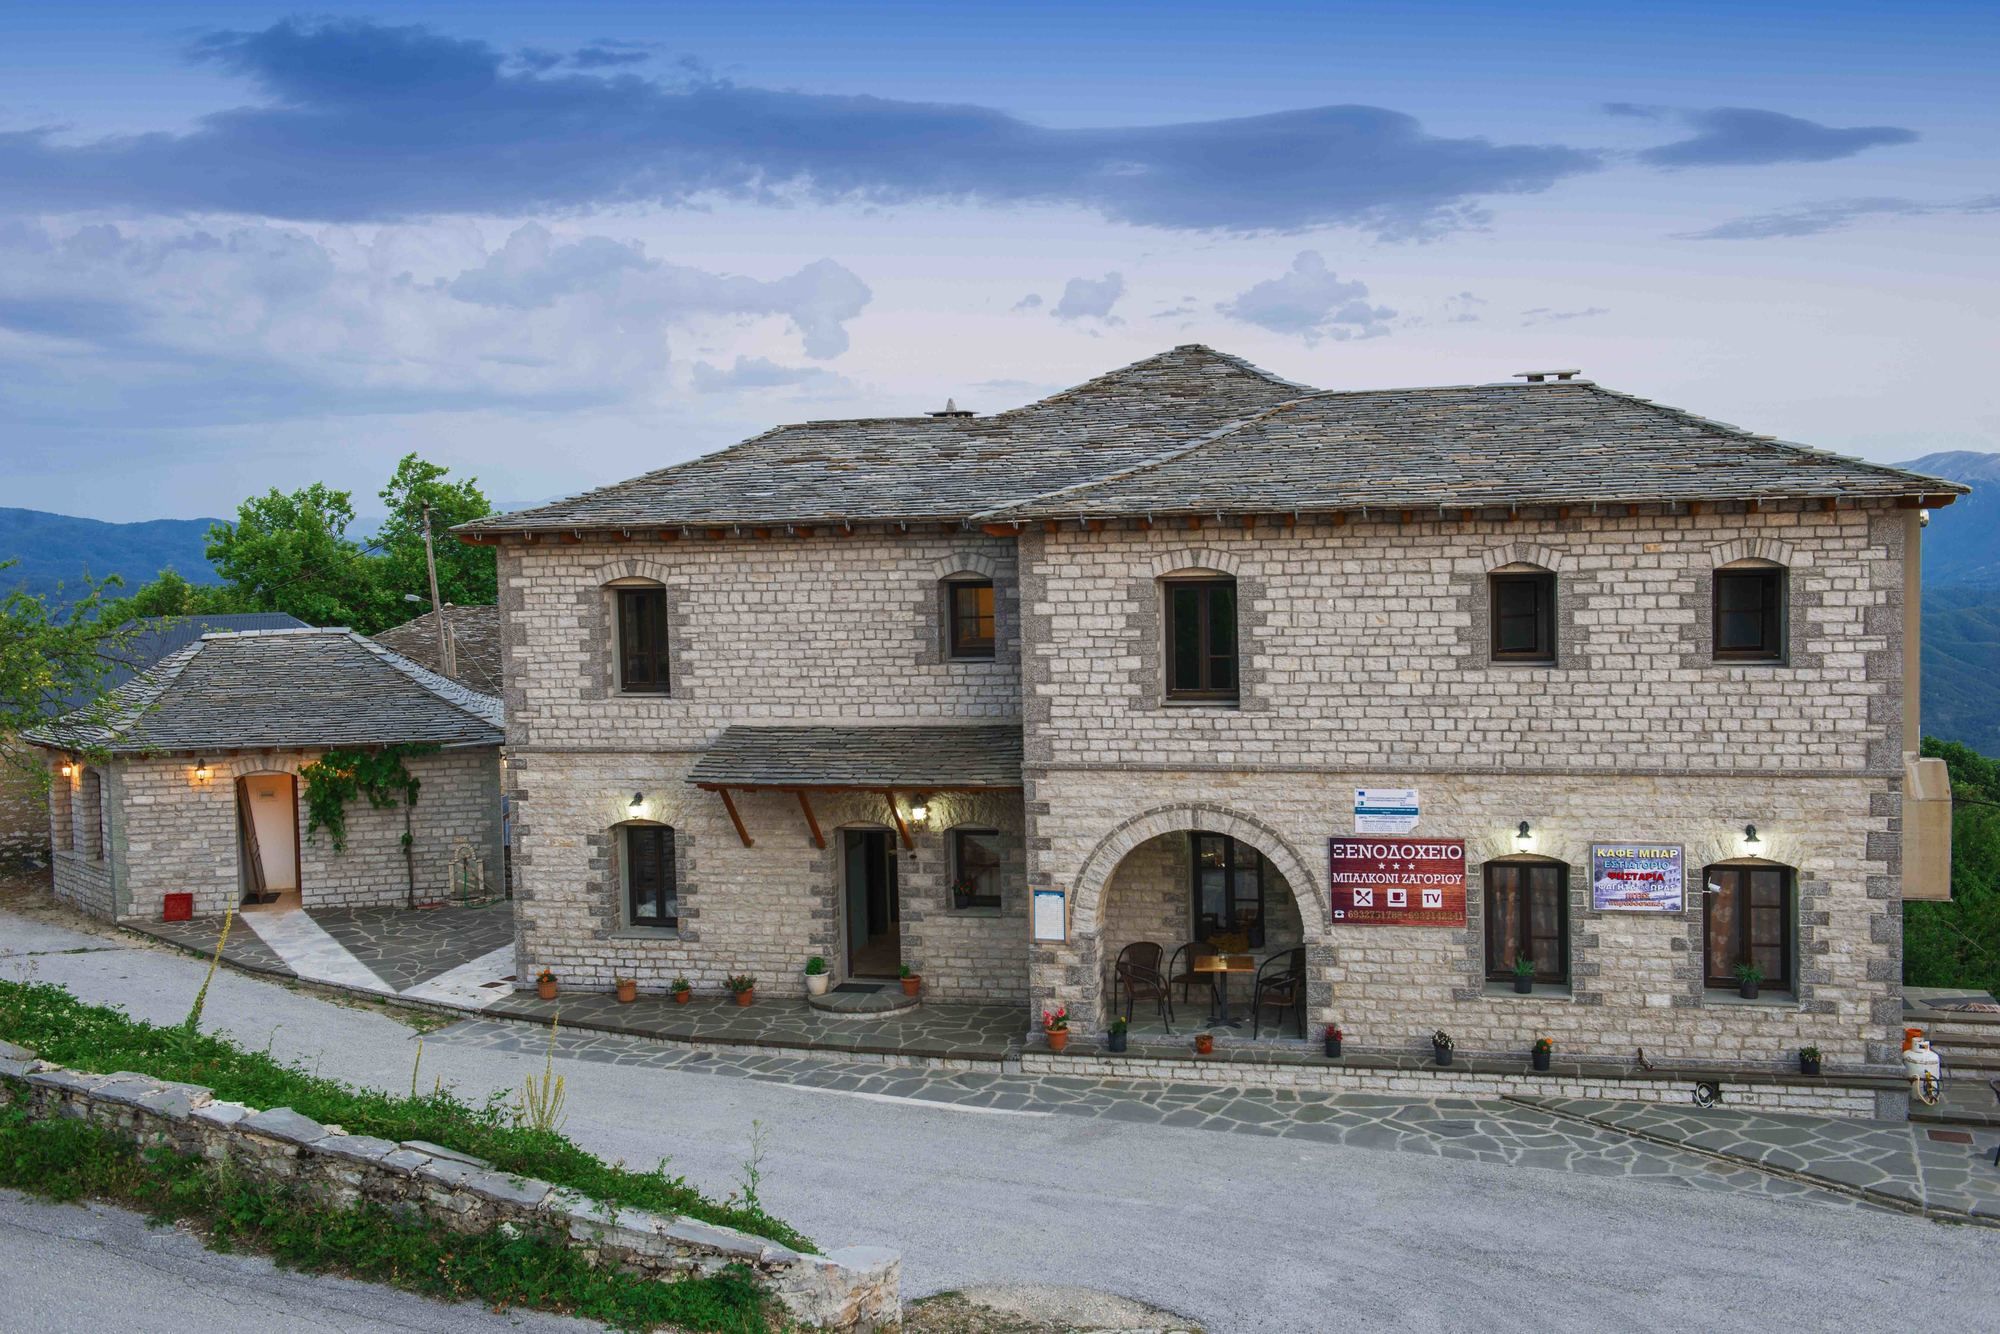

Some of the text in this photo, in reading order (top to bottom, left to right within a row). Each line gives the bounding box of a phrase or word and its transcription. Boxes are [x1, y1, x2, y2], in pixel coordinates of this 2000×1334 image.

[1333, 844, 1463, 860] ΞΕΝΟΔΟΧΕΙΟ
[1597, 848, 1679, 858] ΚΑΦΕ ΜΠΑΡ
[1604, 860, 1670, 870] ΕΣΤΙΑΤΟΡΙΟ
[1332, 872, 1463, 886] ΜΠΑΛΚΟΝΙ ΖΑΓΟΡΙΟΥ
[1424, 893, 1440, 904] TV
